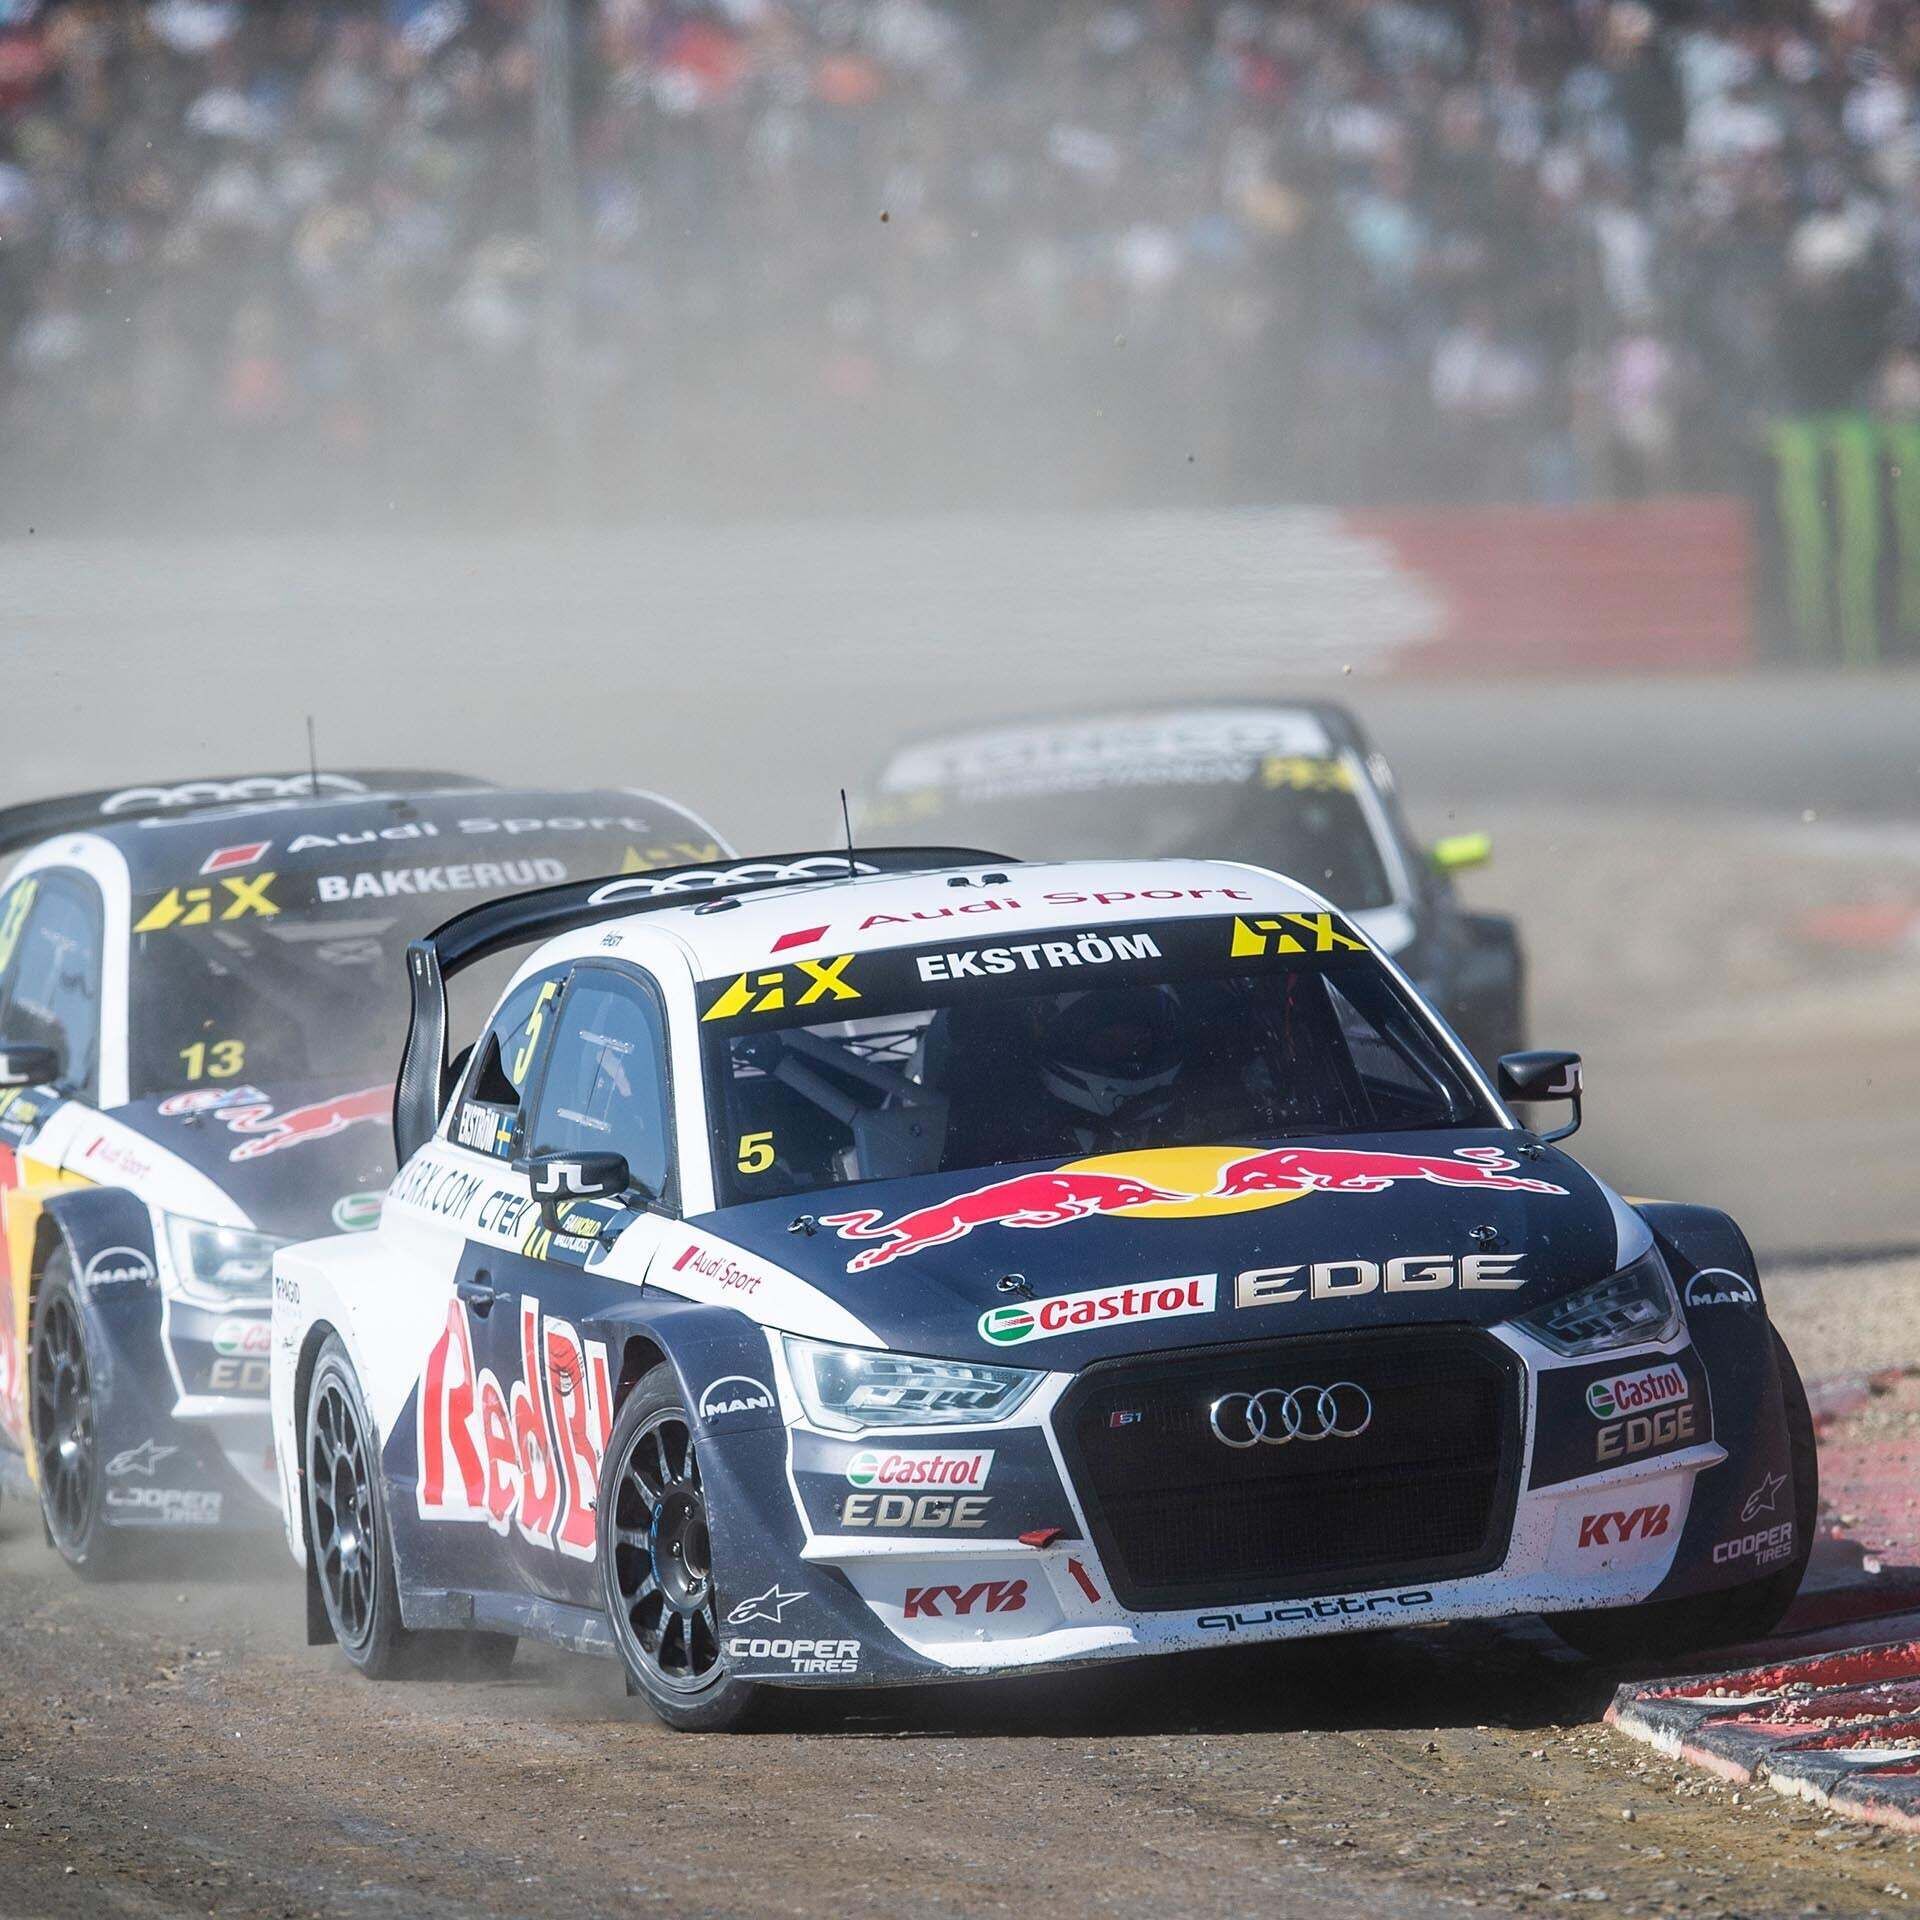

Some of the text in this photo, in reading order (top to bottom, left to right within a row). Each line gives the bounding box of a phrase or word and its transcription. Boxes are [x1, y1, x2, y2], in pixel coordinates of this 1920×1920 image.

[287, 815, 652, 853] Audi Sport
[317, 857, 568, 902] BAKKERUD
[858, 886, 1253, 931] Audi Sport
[916, 932, 1162, 983] EKSTRÖM
[513, 980, 557, 1086] 5
[179, 1039, 246, 1081] 13
[737, 1131, 776, 1175] 5
[478, 1190, 534, 1238] CTEK
[689, 1249, 762, 1294] Audi Sport
[1235, 1252, 1529, 1310] EDGE
[1039, 1280, 1204, 1331] Castrol
[1690, 1289, 1752, 1306] MAN
[704, 1396, 768, 1416] MAN
[1614, 1367, 1685, 1411] Castrol
[1595, 1404, 1695, 1462] EDGE
[878, 1454, 981, 1485] Castrol
[841, 1494, 995, 1529] EDGE
[1578, 1504, 1672, 1548] KYB
[1713, 1521, 1793, 1564] COOPER
[1754, 1540, 1792, 1566] TIRES
[902, 1579, 1029, 1619] KYB
[1196, 1590, 1434, 1632] quattro
[727, 1637, 860, 1660] COOPER
[791, 1659, 859, 1673] TIRES
